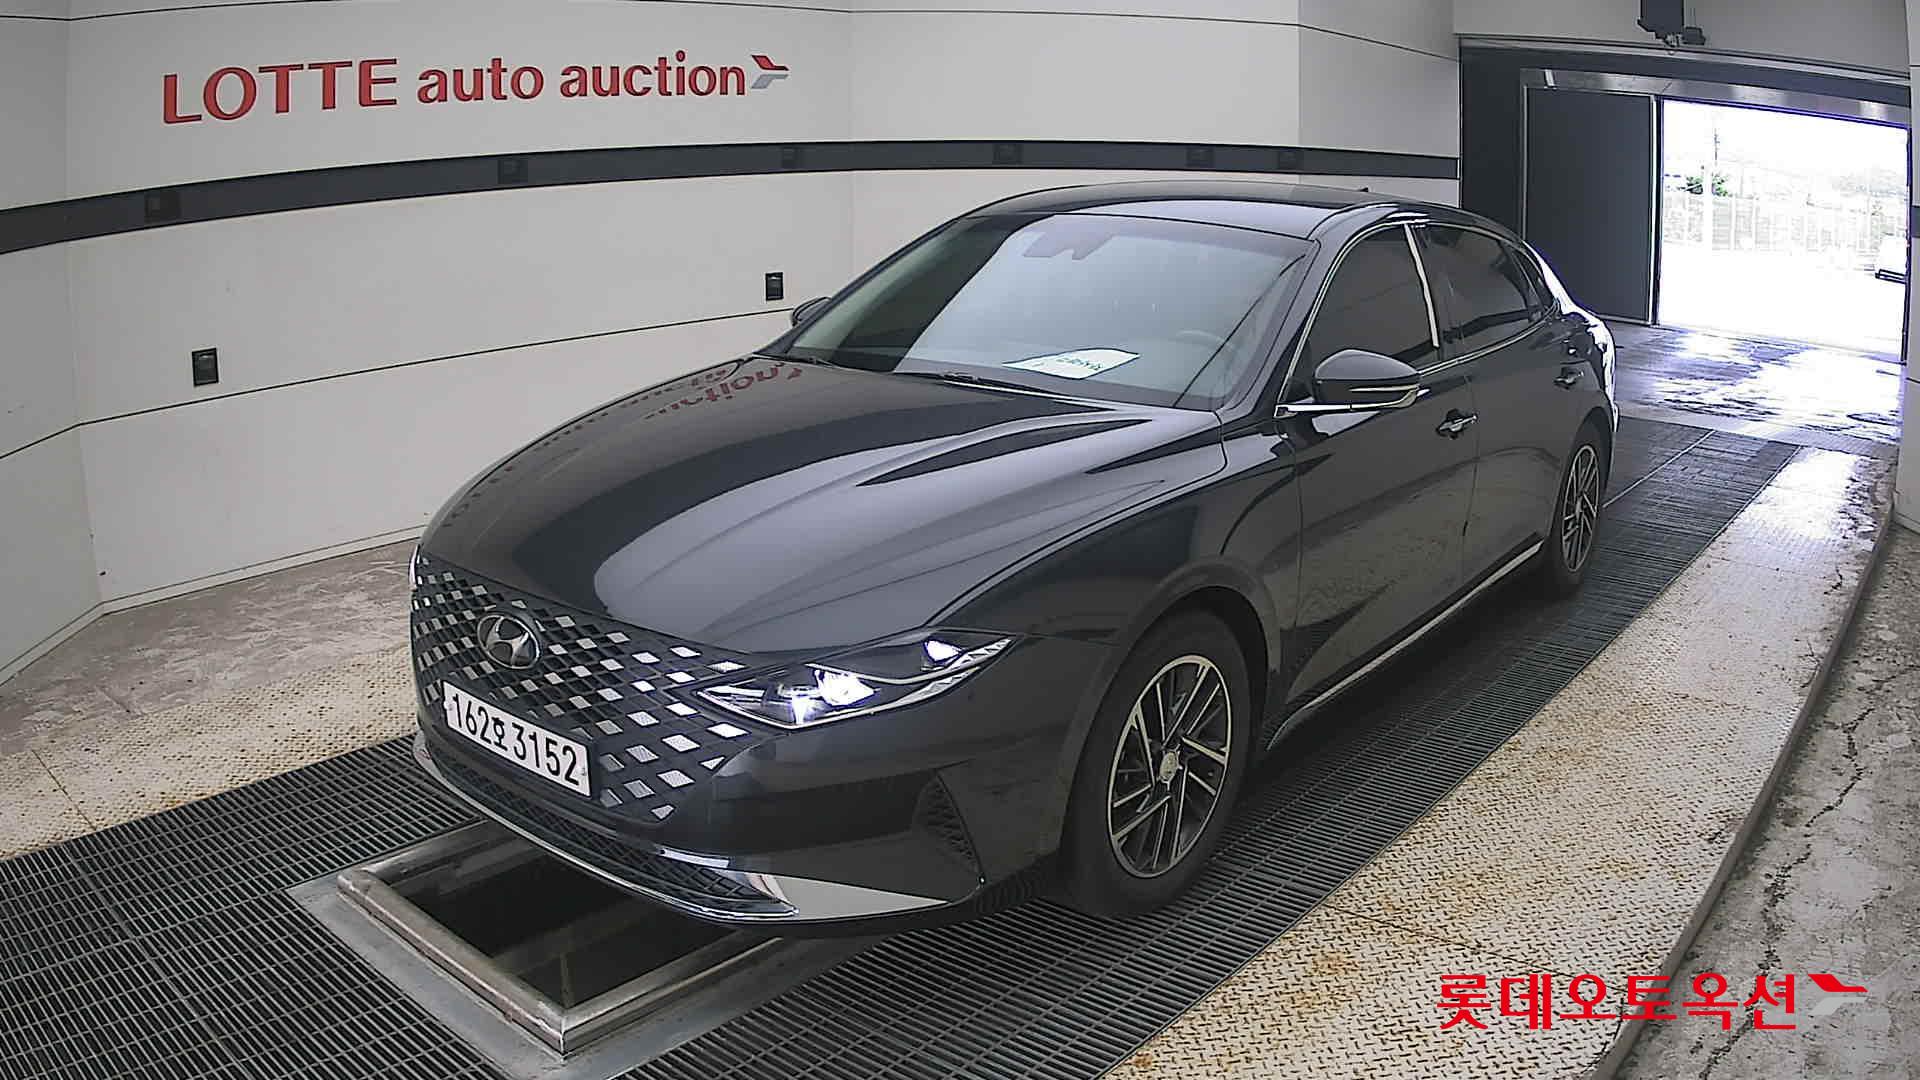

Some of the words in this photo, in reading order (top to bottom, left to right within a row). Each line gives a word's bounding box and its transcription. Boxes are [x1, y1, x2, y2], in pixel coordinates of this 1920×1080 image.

[164, 58, 397, 124] LOTTE
[417, 58, 544, 103] auto
[560, 50, 746, 98] auction
[452, 693, 508, 751] 162호
[511, 722, 580, 786] 3152
